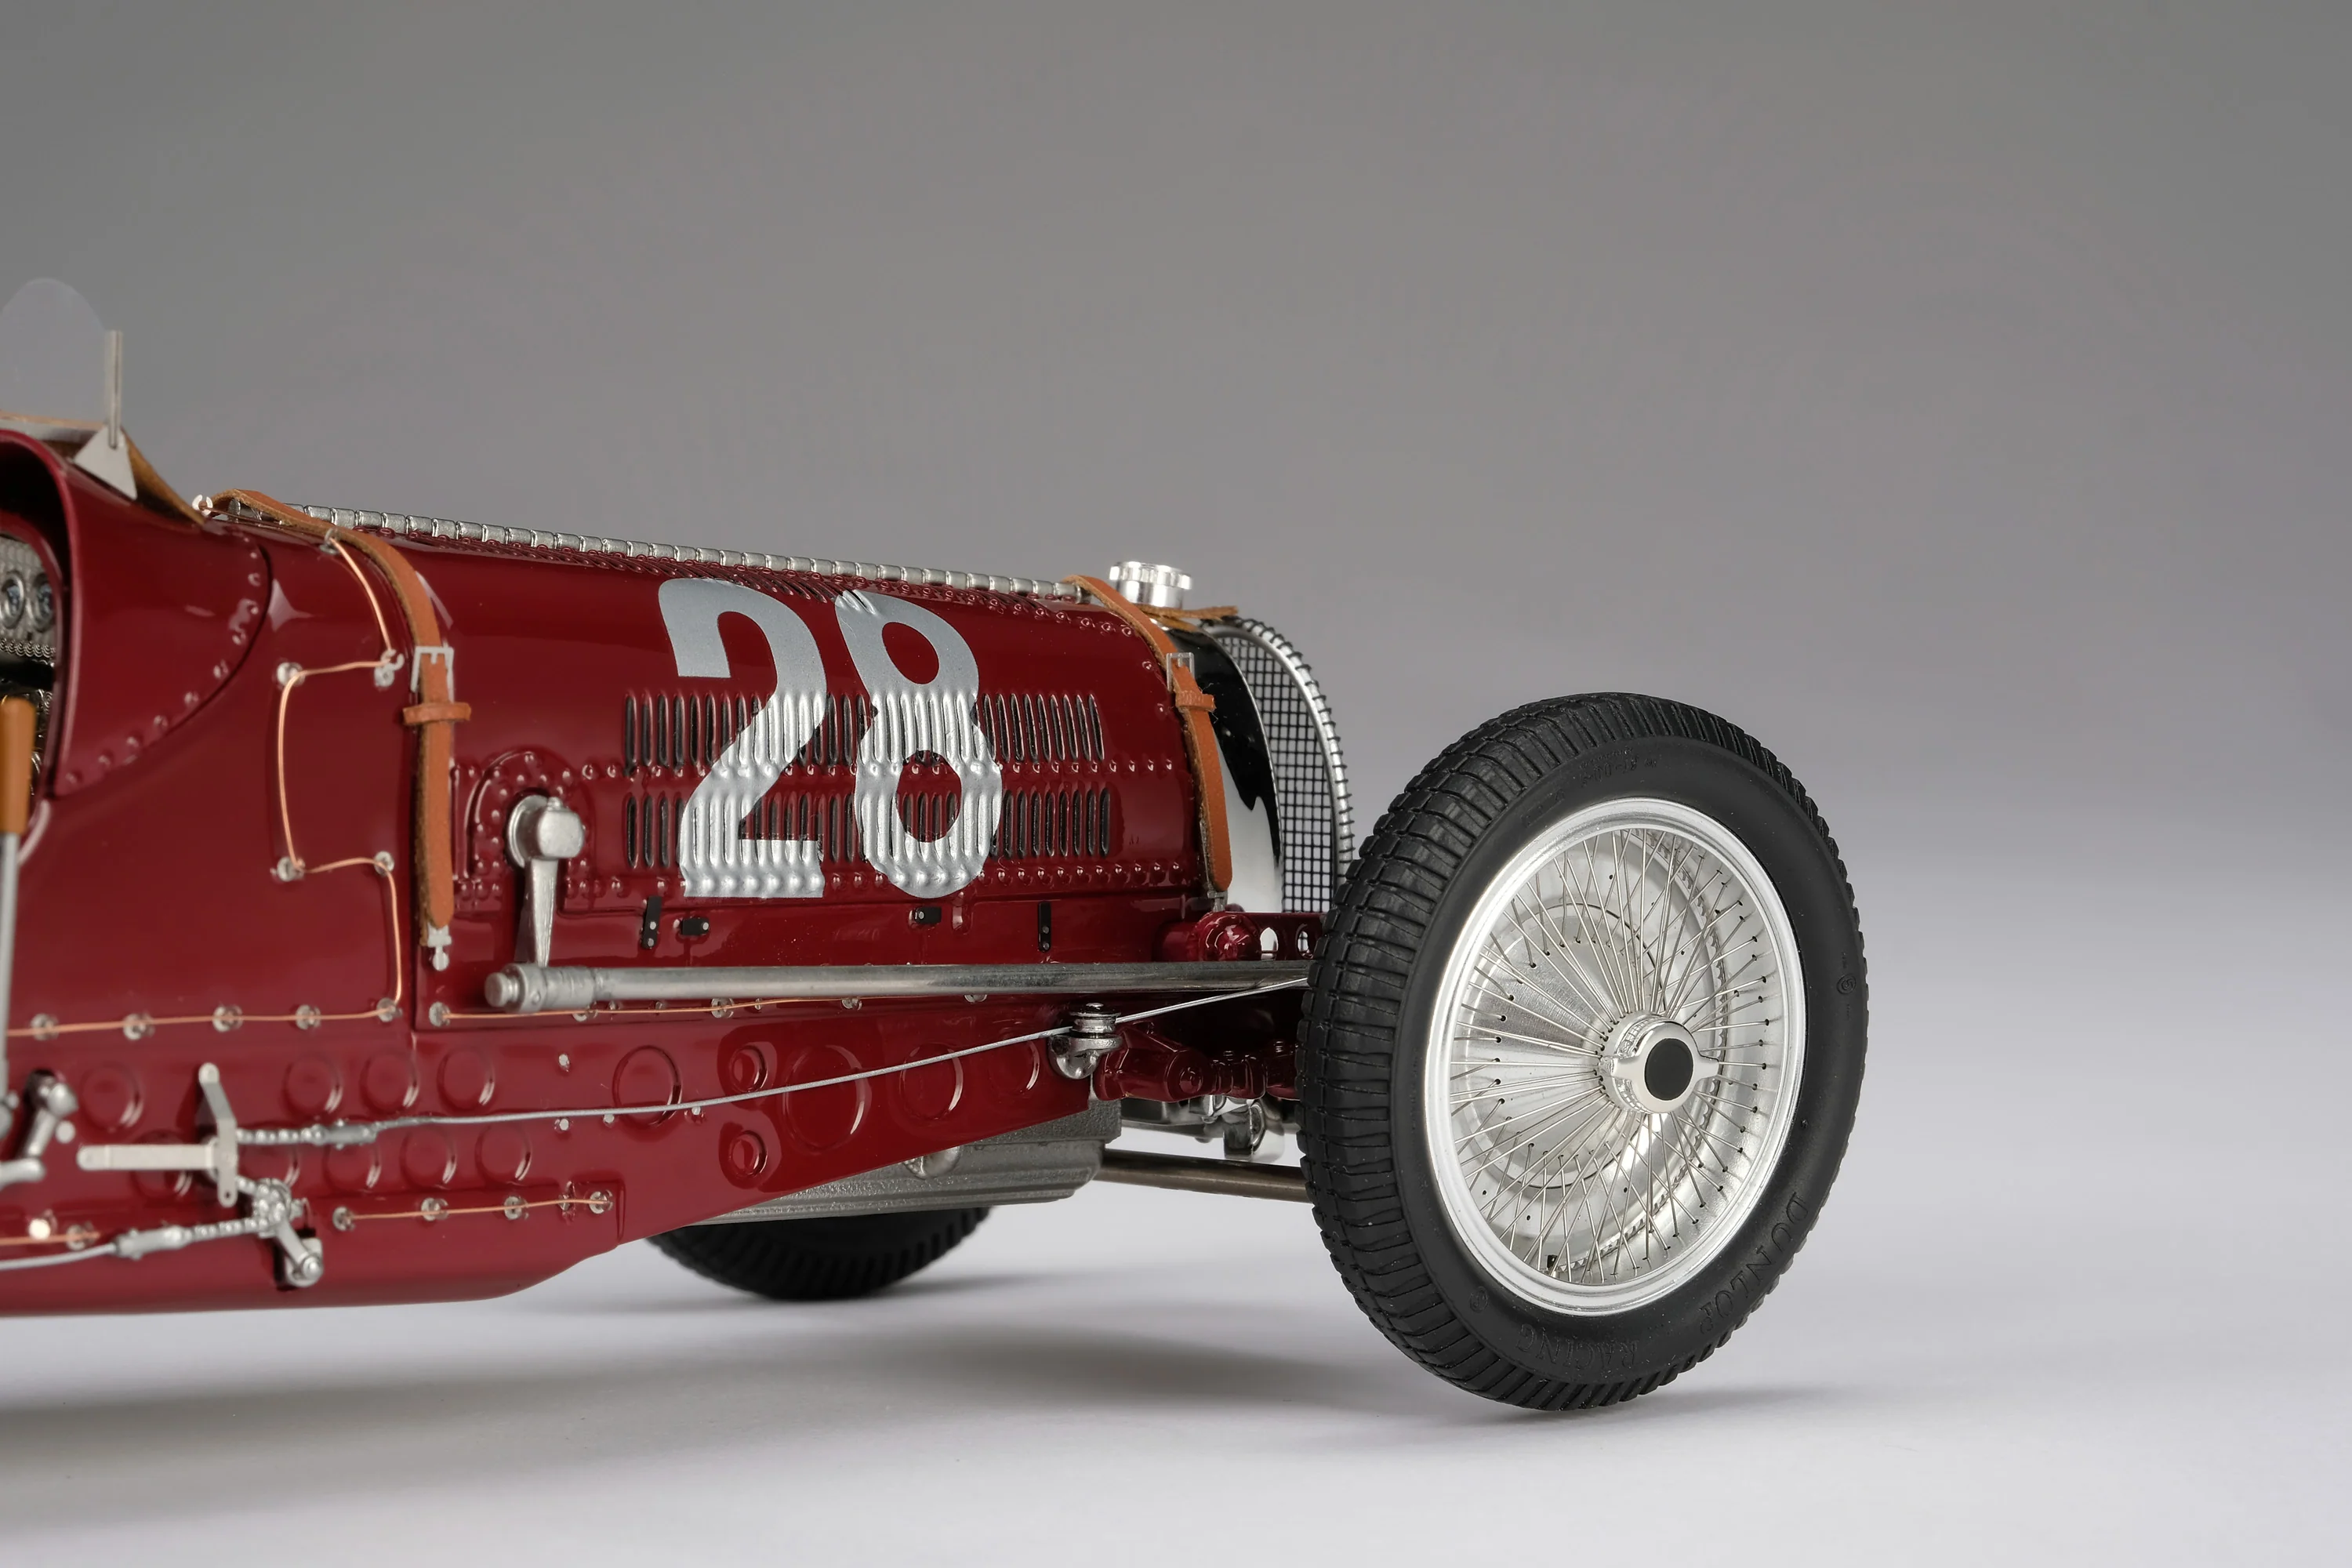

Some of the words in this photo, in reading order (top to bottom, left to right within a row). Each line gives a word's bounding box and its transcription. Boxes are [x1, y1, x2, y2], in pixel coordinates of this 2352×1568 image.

[658, 578, 1002, 898] 28
[1699, 1191, 1809, 1334] DUNLOP
[1515, 1323, 1639, 1369] RACING
